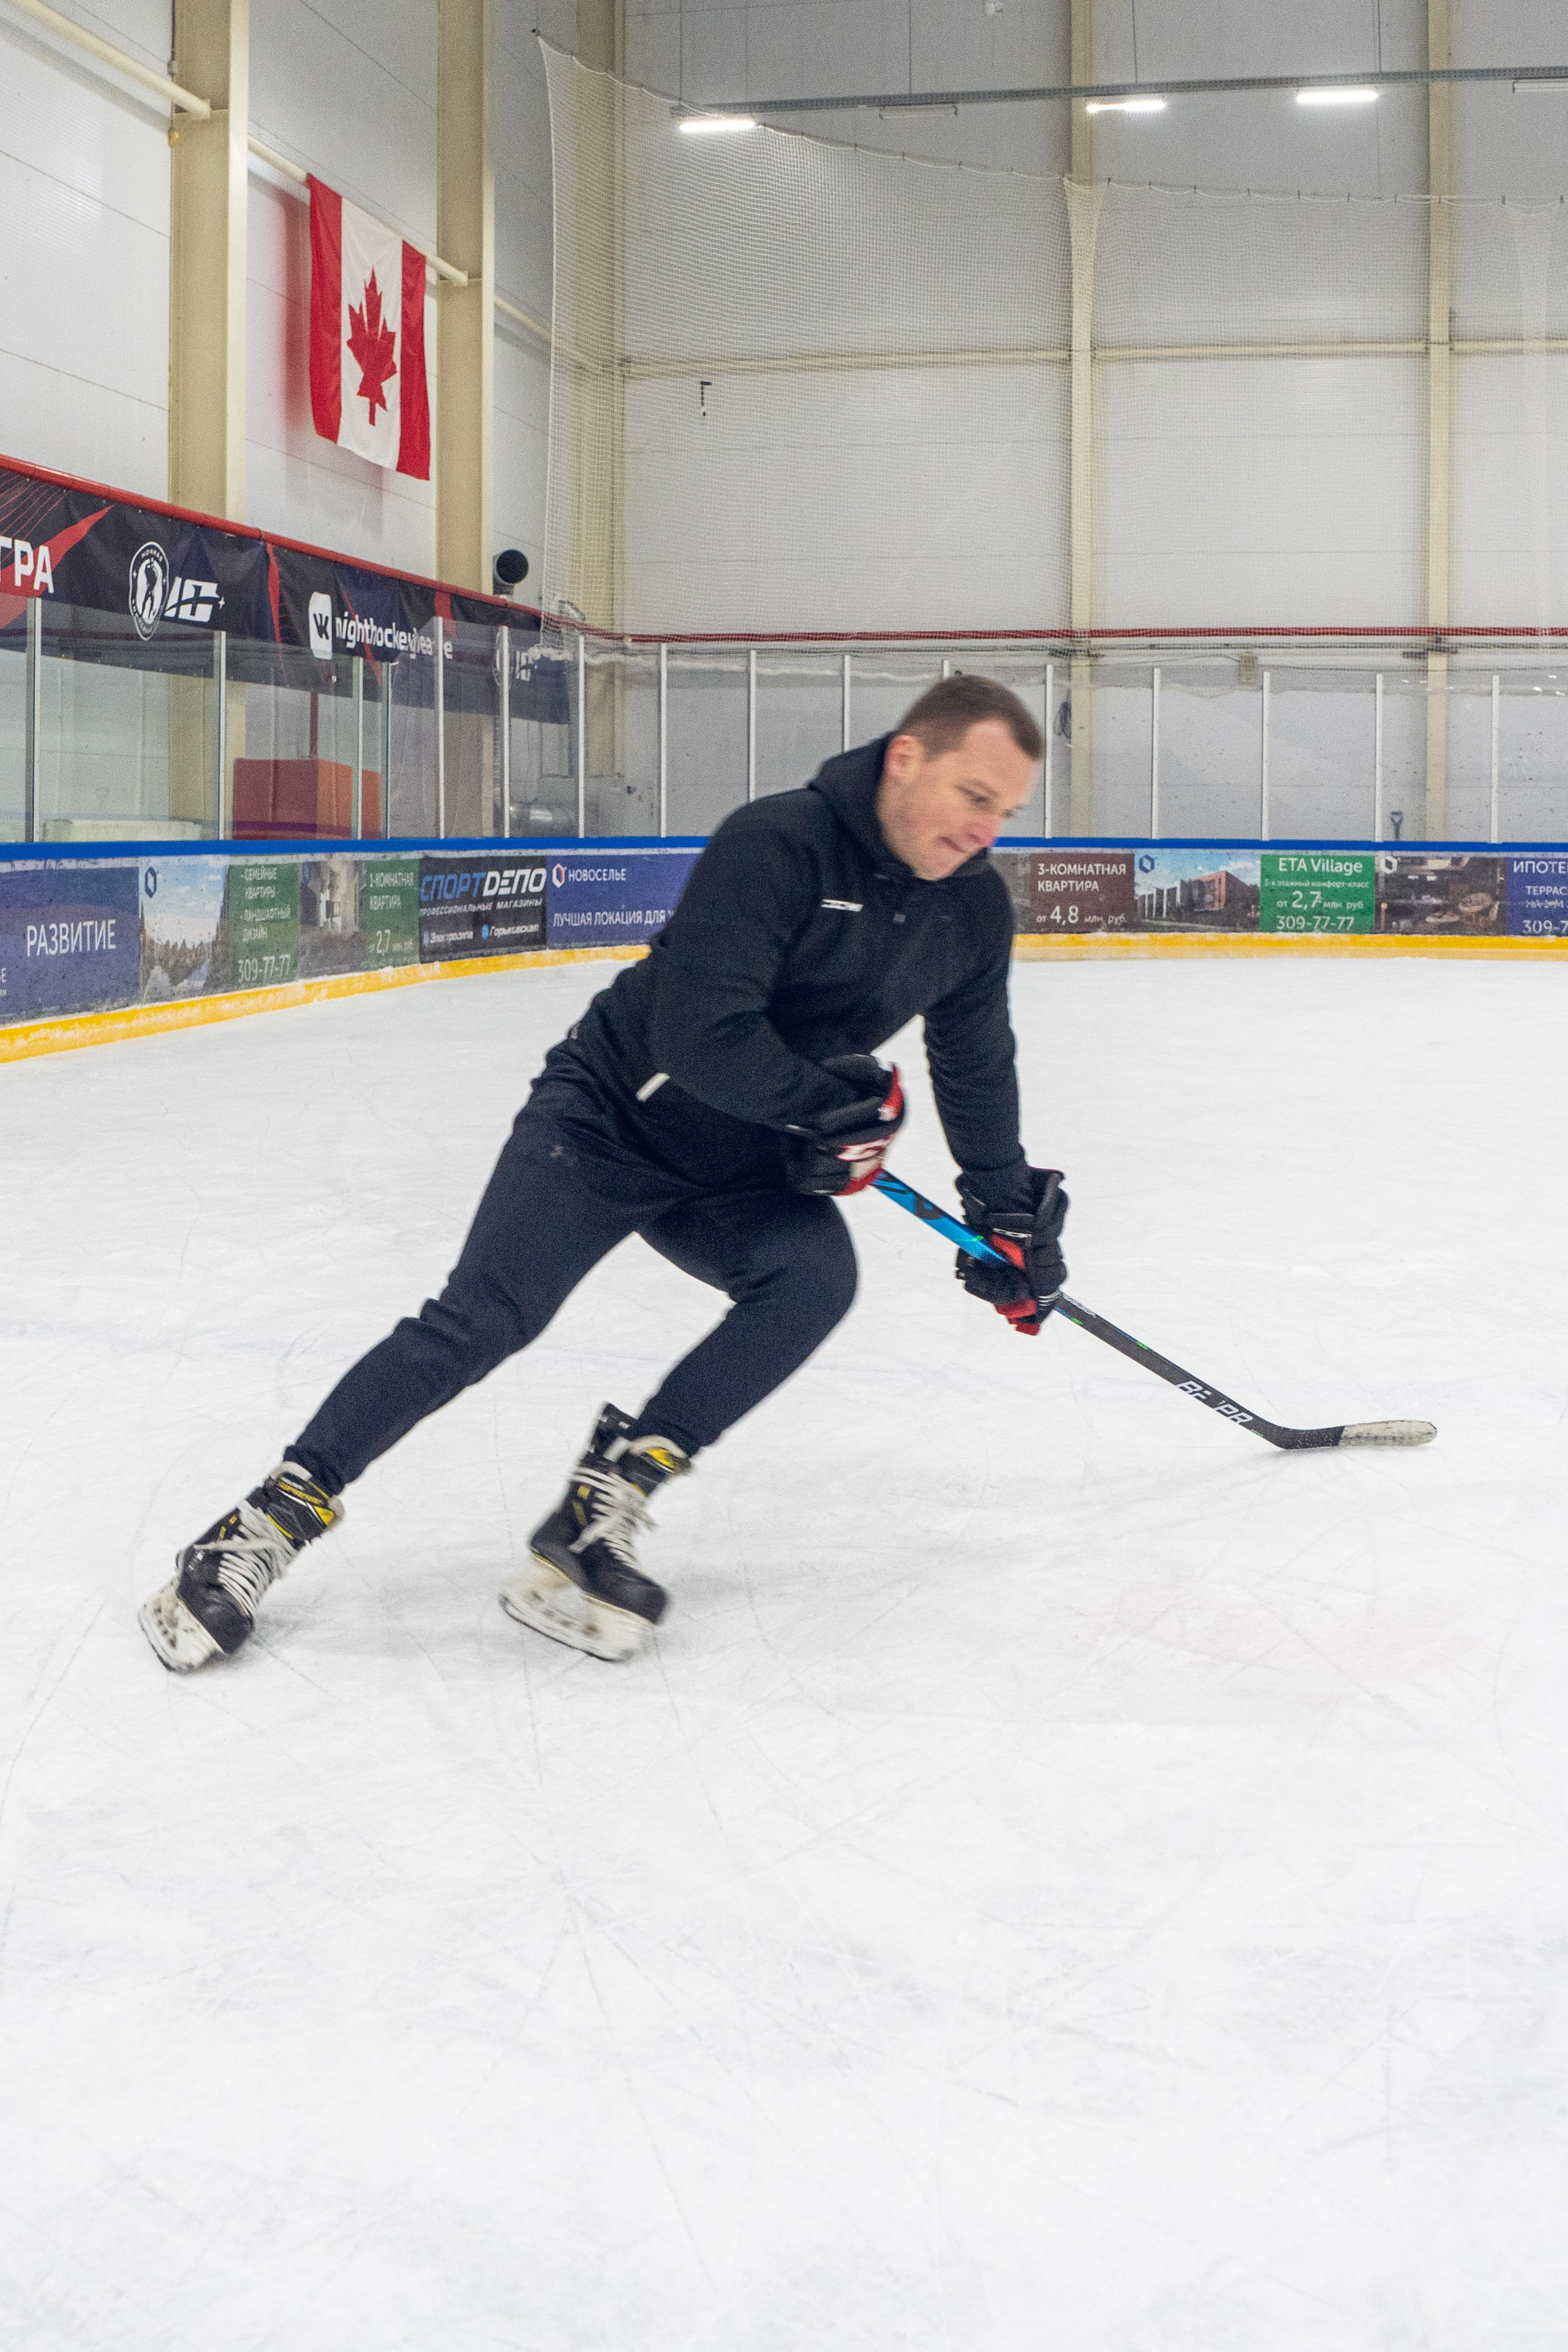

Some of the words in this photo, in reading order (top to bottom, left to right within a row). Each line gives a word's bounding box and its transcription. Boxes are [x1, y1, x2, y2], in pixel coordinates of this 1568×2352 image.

[1038, 863, 1127, 875] 3-КОМНАТНАЯ
[1278, 858, 1308, 872] ETA
[1310, 858, 1363, 876] Village
[1513, 861, 1568, 873] ИПОТЕ
[568, 869, 627, 882] НОВОСЕЛЬЕ
[1038, 880, 1099, 892] КВАРТИРА
[496, 898, 543, 910] МАГАЗИНЫ
[1291, 891, 1322, 910] 2,7
[552, 912, 592, 927] ЛУЧШАЯ
[594, 910, 643, 926] ЛОКАЦИЯ
[644, 910, 666, 925] ДЛЯ
[1049, 905, 1079, 925] 4,8
[1276, 916, 1355, 930] 309-77-77
[26, 919, 116, 957] РАЗВИТИЕ
[238, 953, 291, 982] 309-77-77
